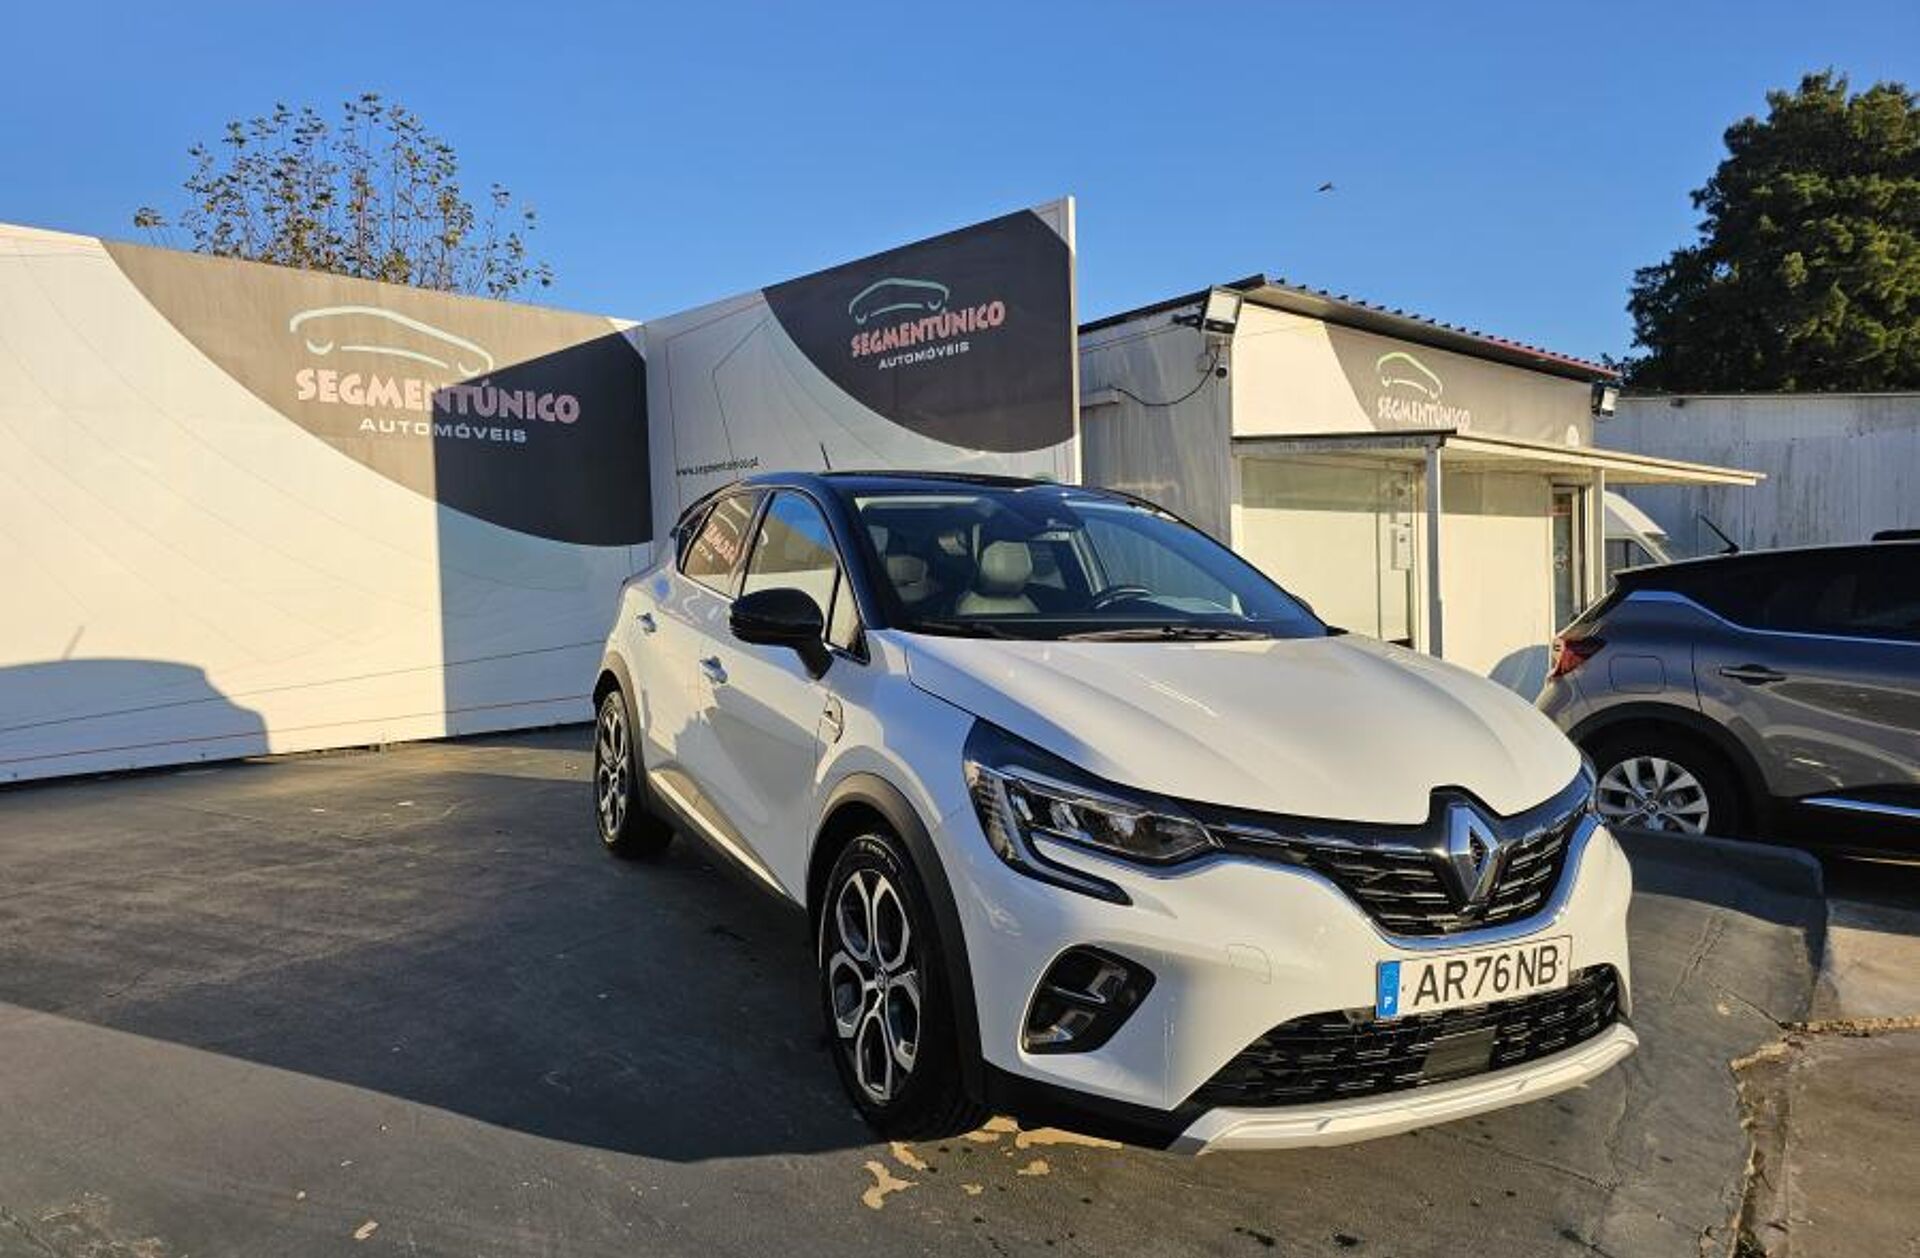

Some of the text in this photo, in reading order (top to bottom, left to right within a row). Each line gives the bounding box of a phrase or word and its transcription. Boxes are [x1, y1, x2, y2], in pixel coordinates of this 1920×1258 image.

[850, 300, 1006, 357] SEGMENTÚNICO
[878, 341, 970, 371] AUTOMÓVEIS
[295, 368, 581, 424] SEGMENTÚNICO
[358, 418, 527, 444] AUTOMÓVEIS
[1383, 997, 1393, 1010] P
